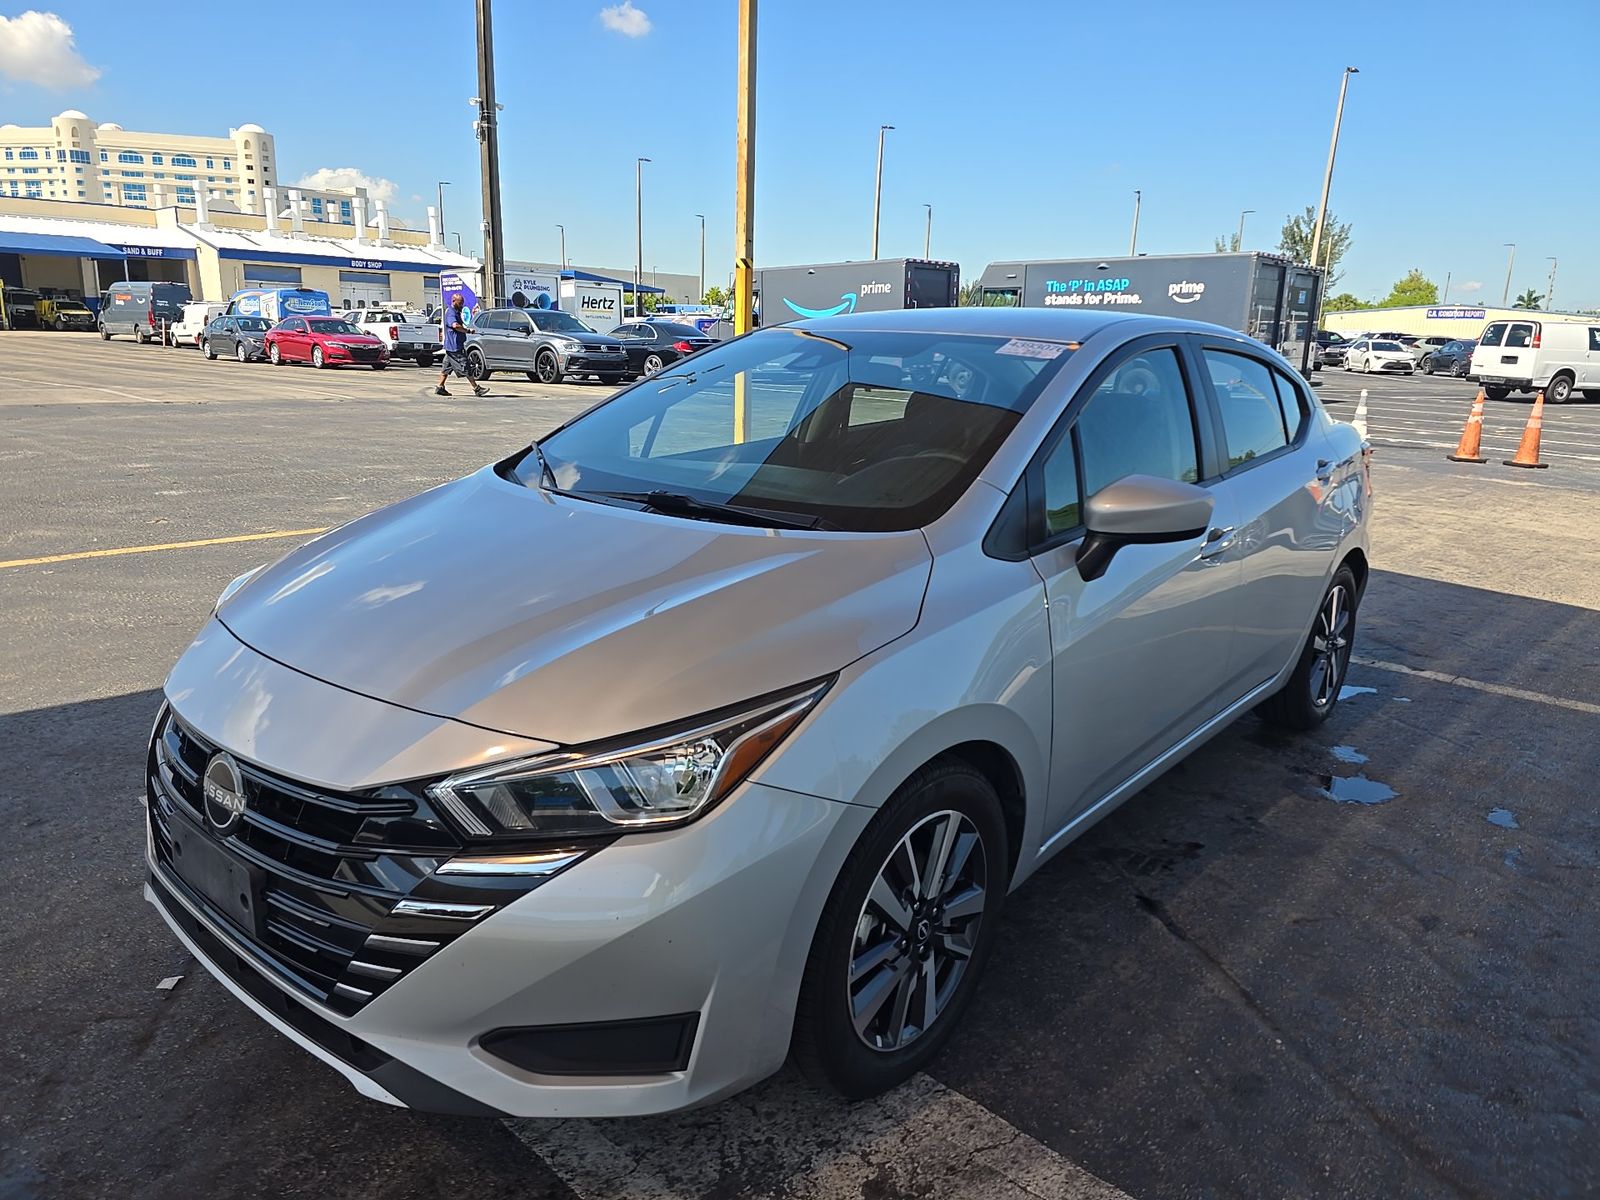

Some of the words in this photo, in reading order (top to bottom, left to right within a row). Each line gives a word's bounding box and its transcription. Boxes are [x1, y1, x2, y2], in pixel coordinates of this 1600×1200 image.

[122, 246, 140, 255] SAND
[147, 248, 163, 256] BUFF
[351, 260, 366, 268] BODY
[367, 261, 382, 269] SHOP
[523, 284, 551, 292] PLUMBING
[861, 280, 892, 298] prime
[1046, 280, 1067, 292] The
[1084, 280, 1095, 291] in
[1096, 279, 1130, 291] ASAP
[1168, 281, 1205, 297] prime
[581, 295, 615, 310] Hertz
[1044, 293, 1083, 305] stands
[1084, 292, 1103, 304] for
[1103, 292, 1143, 305] Prime.
